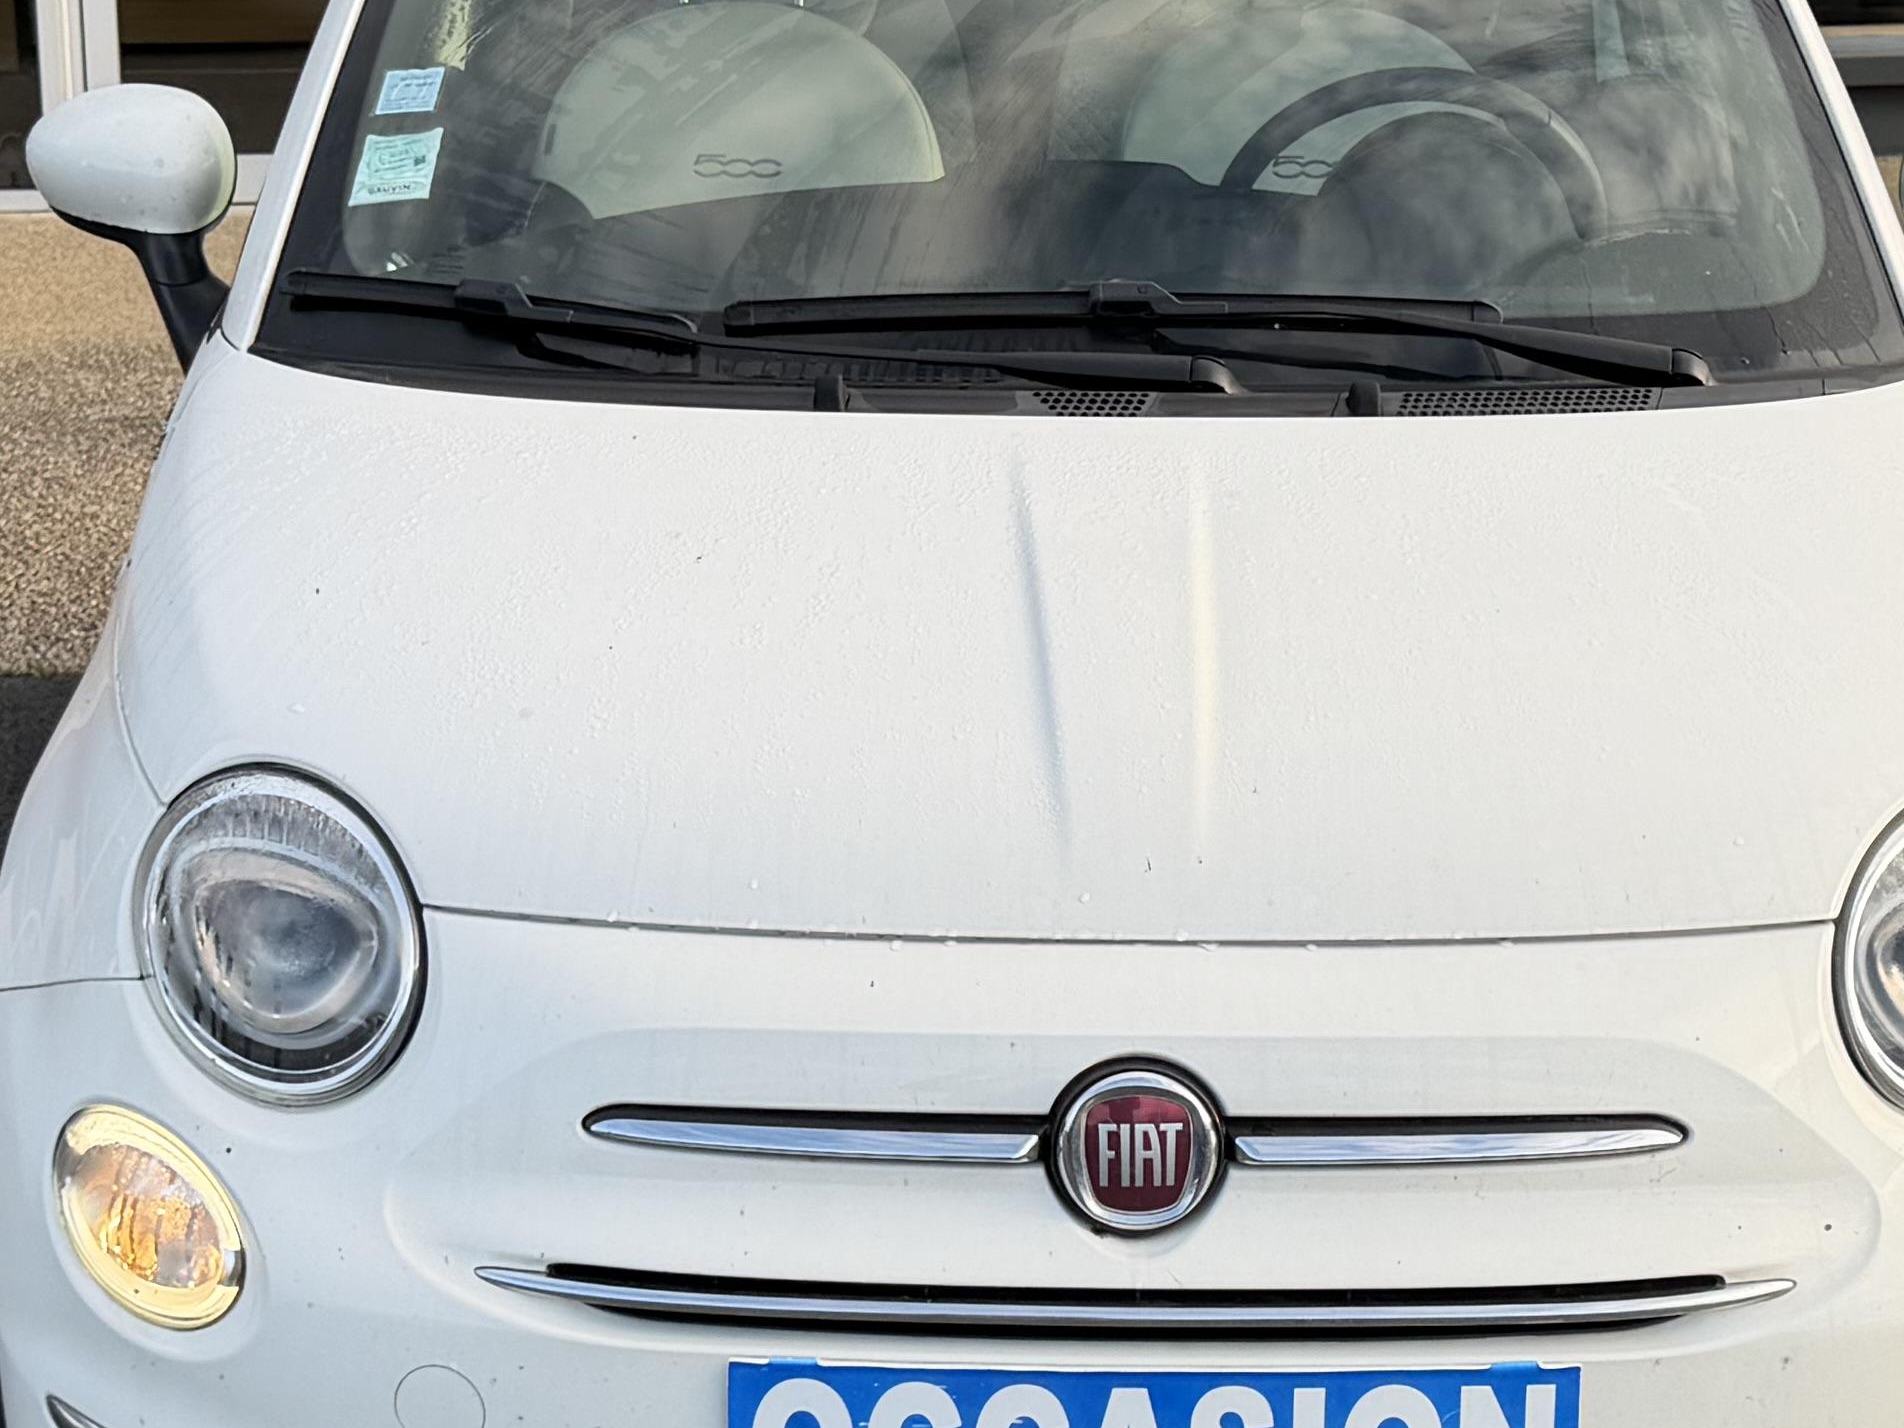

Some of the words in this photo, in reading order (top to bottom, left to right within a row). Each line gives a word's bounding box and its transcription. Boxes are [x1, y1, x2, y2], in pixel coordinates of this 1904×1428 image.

[693, 153, 783, 179] 500
[1272, 155, 1334, 179] 50
[1097, 1123, 1184, 1188] FIAT
